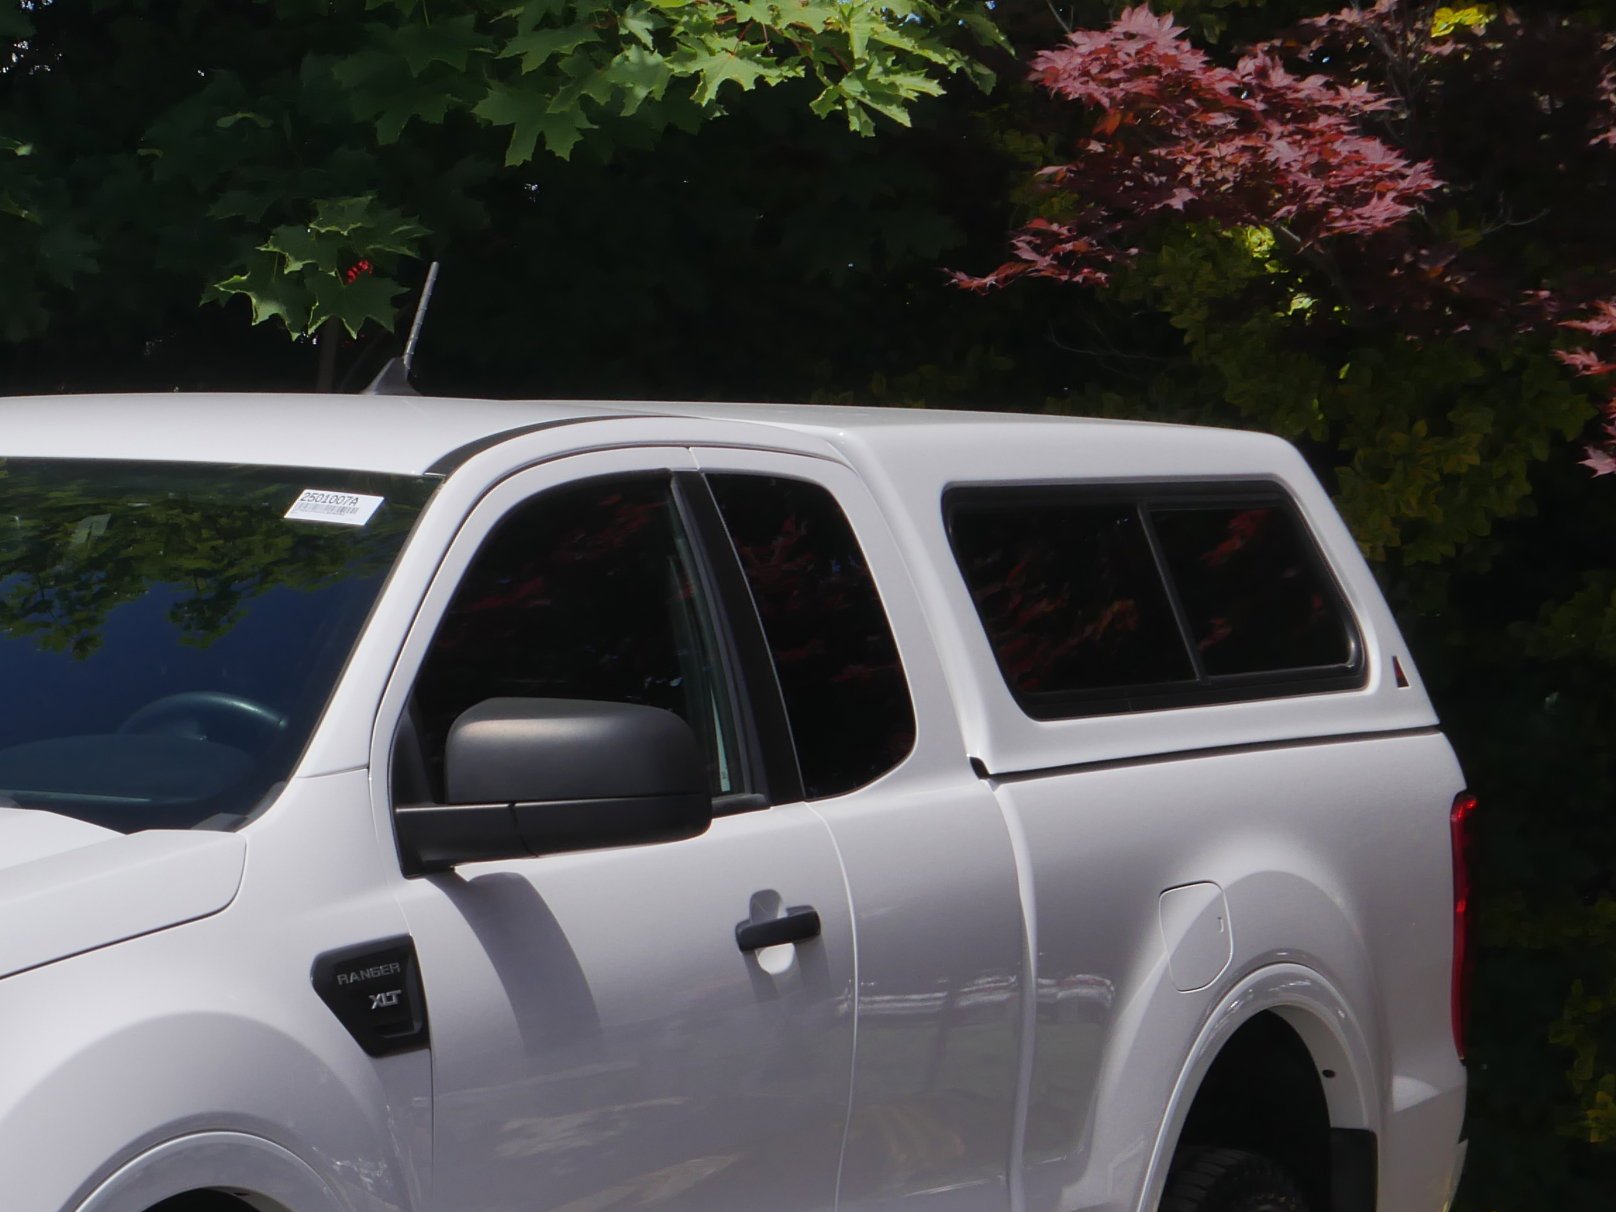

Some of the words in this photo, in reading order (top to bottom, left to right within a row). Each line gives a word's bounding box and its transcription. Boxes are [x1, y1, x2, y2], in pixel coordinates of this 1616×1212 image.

[300, 493, 359, 506] 2501007A
[336, 962, 401, 986] RANGER
[368, 989, 402, 1010] XLT
